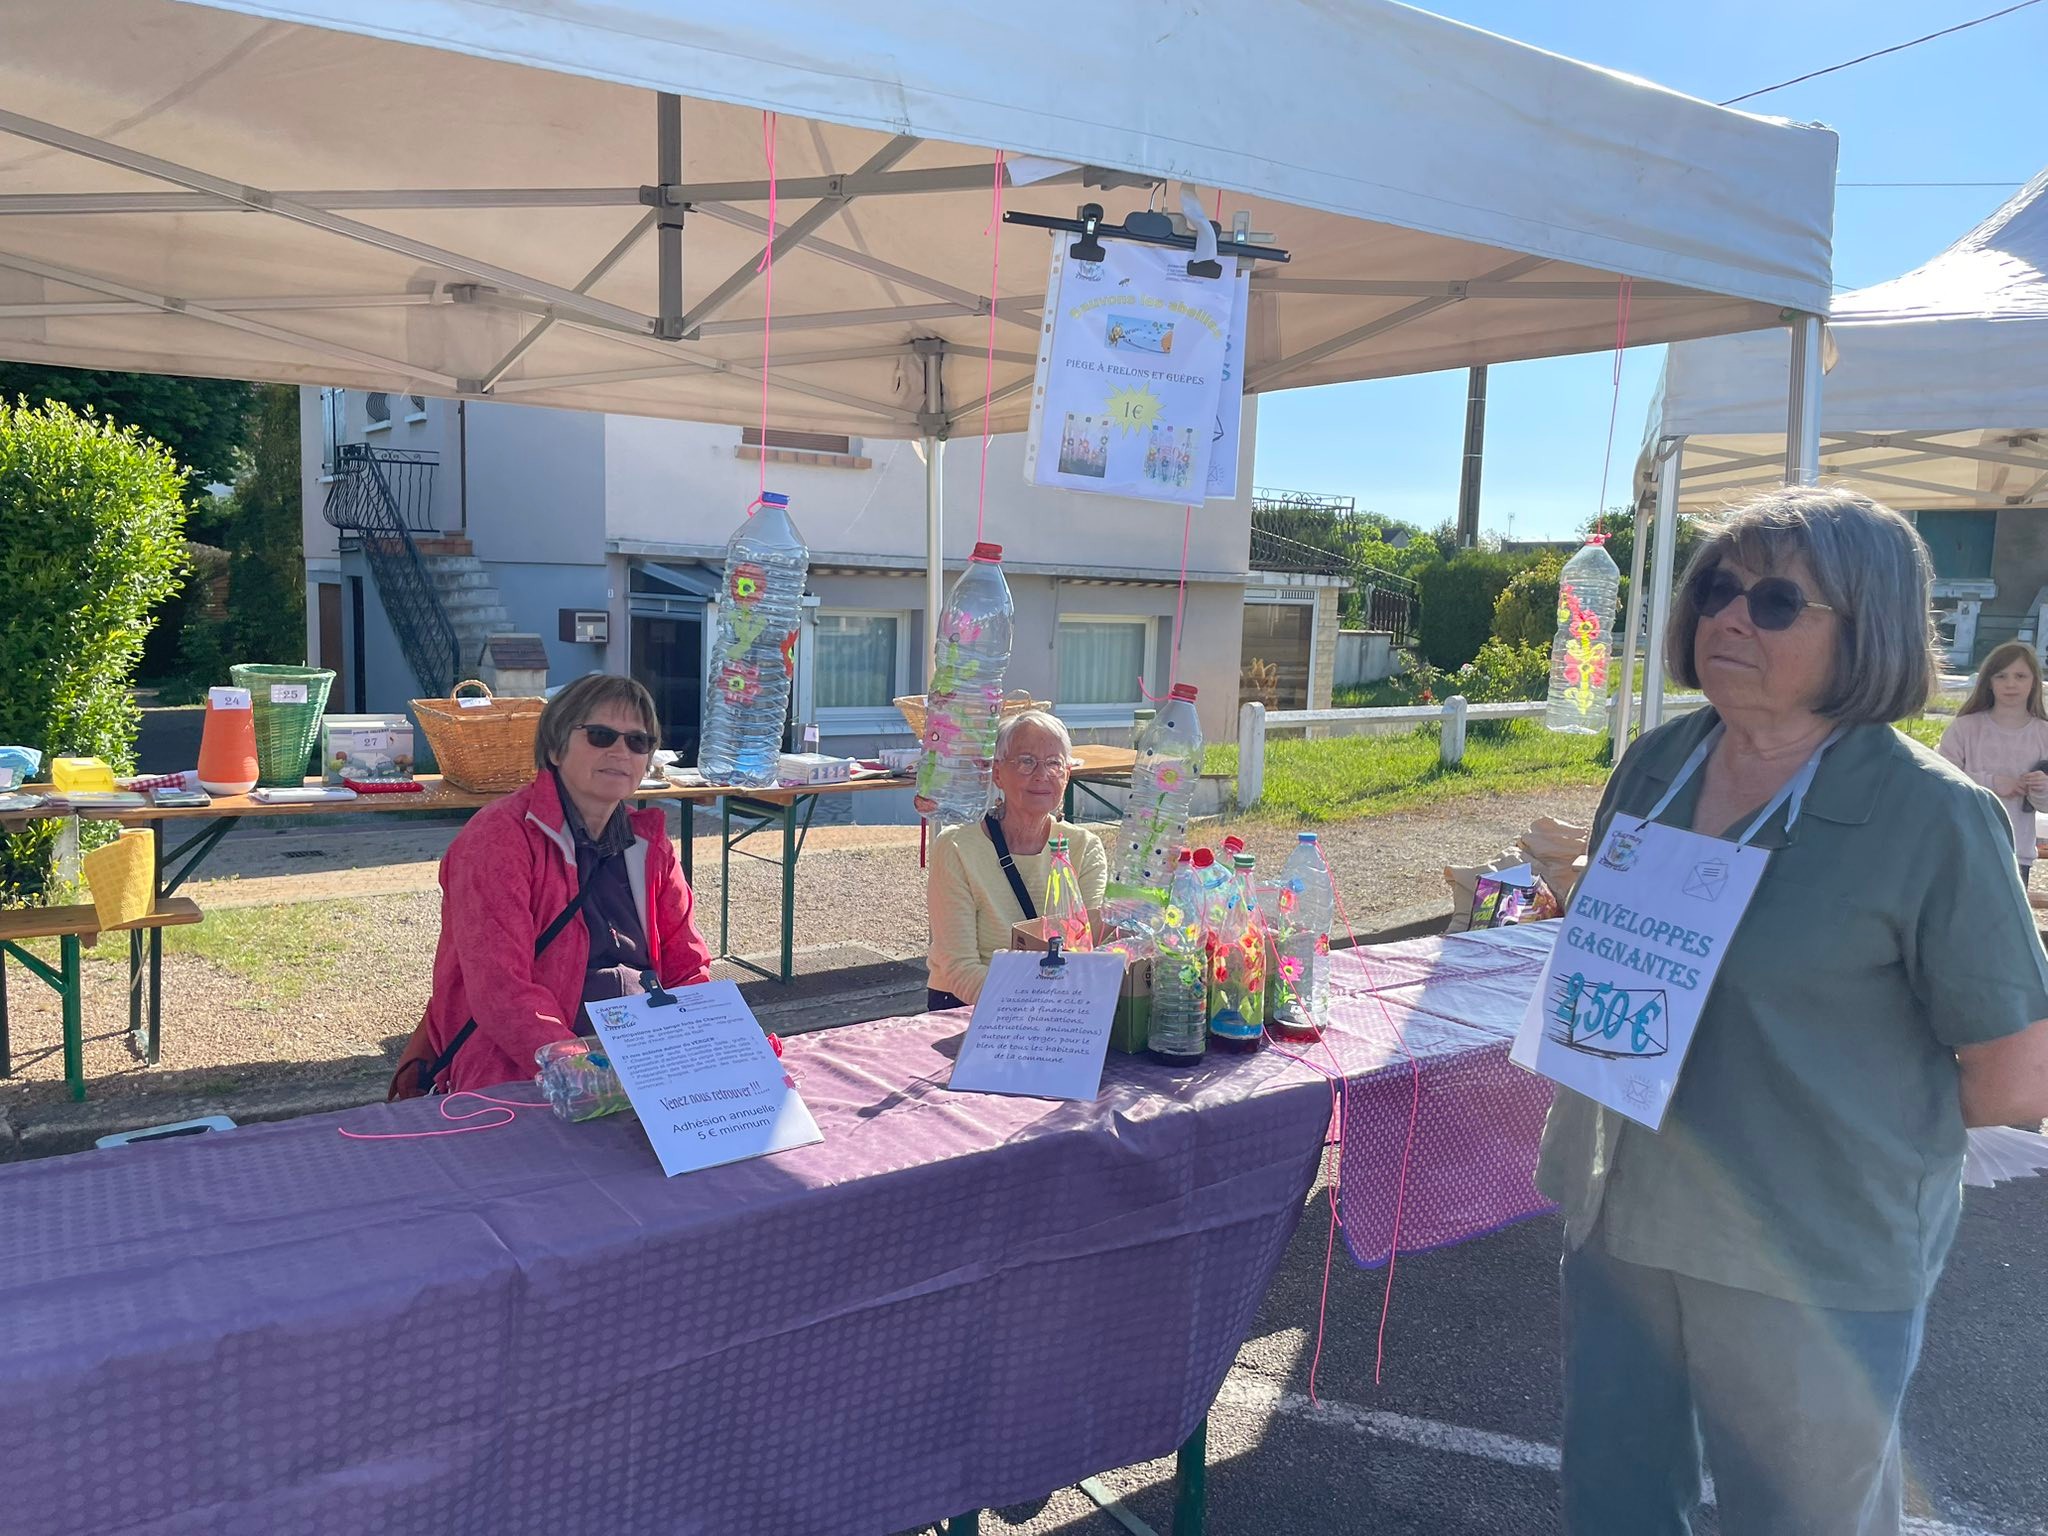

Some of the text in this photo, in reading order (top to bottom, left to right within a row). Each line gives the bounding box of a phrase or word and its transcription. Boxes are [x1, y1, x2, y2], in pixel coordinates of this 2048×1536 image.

[1107, 364, 1150, 379] FRELONS
[1151, 371, 1165, 380] ET
[283, 690, 298, 699] 25
[224, 696, 239, 706] 24
[364, 737, 378, 747] 27
[1574, 895, 1715, 959] ENVELOPPES
[1567, 925, 1701, 991] GAGNANTES
[1031, 988, 1069, 996] bénéfices
[1038, 1005, 1075, 1014] financer
[996, 1015, 1024, 1023] projets
[1045, 1026, 1102, 1036] animations)
[997, 1042, 1007, 1050] de
[1009, 1043, 1029, 1051] tous
[1031, 1044, 1043, 1052] les
[1045, 1045, 1090, 1055] habitants
[659, 1095, 690, 1111] Venez
[688, 1091, 712, 1104] nous
[711, 1086, 752, 1101] retrouver
[673, 1114, 727, 1133] Adhésion
[728, 1104, 776, 1120] annuelle
[697, 1118, 771, 1140] 5 € minimum
